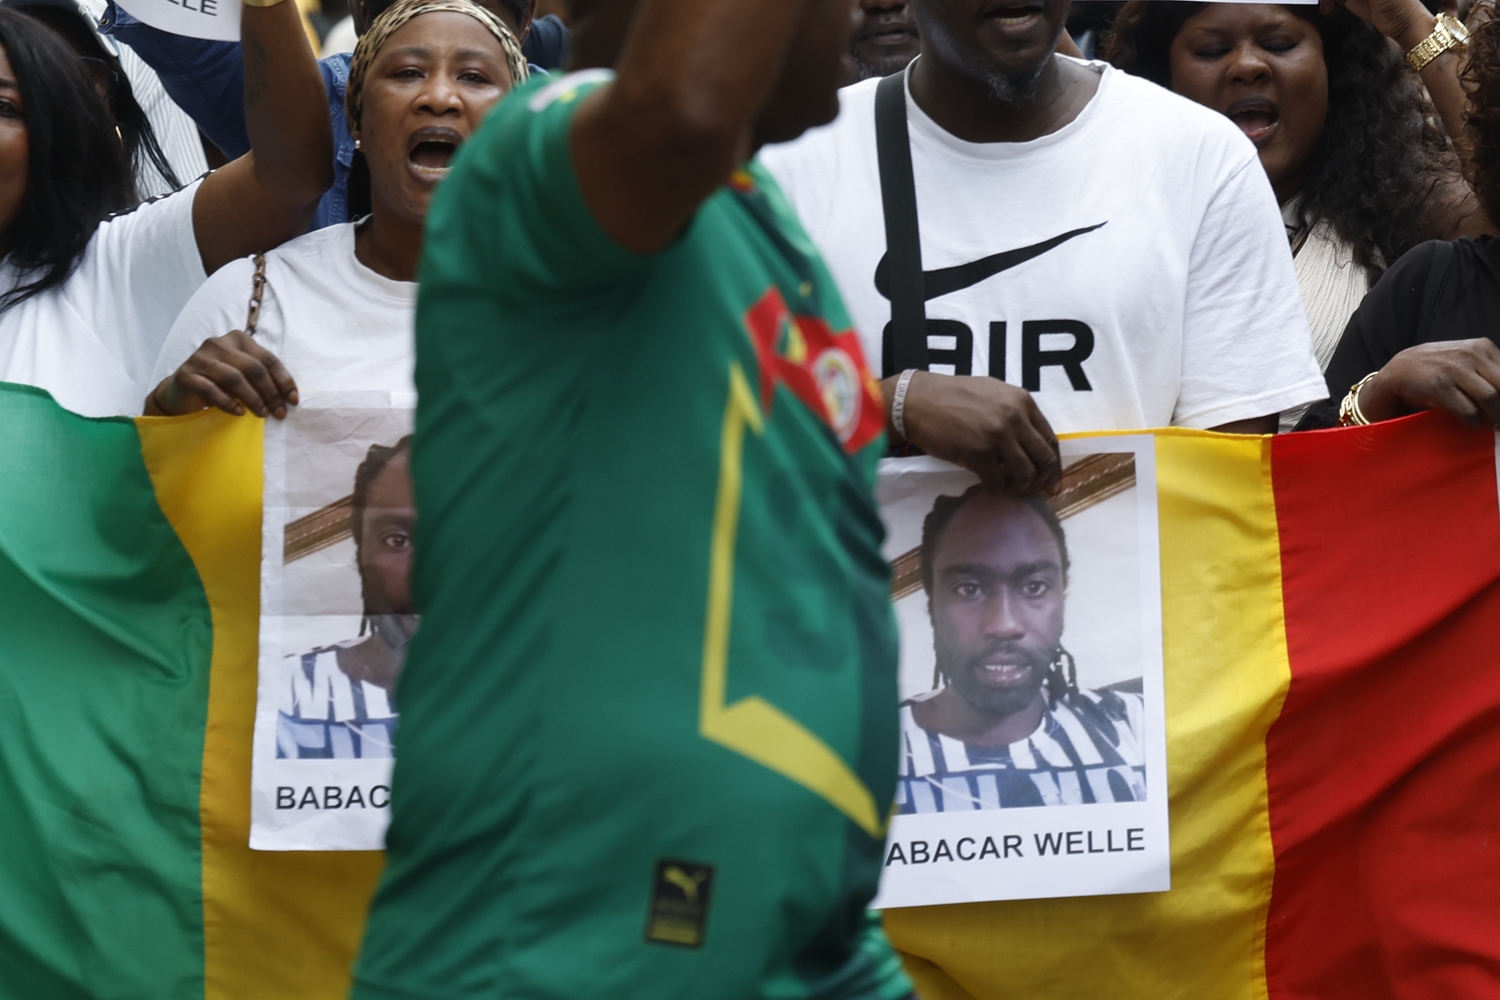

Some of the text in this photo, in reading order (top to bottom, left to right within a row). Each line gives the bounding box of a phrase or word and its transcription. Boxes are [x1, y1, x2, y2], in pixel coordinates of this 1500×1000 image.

[882, 318, 1094, 392] AIR
[275, 784, 392, 810] BABAC
[884, 827, 1145, 867] ABACAR WELLE
